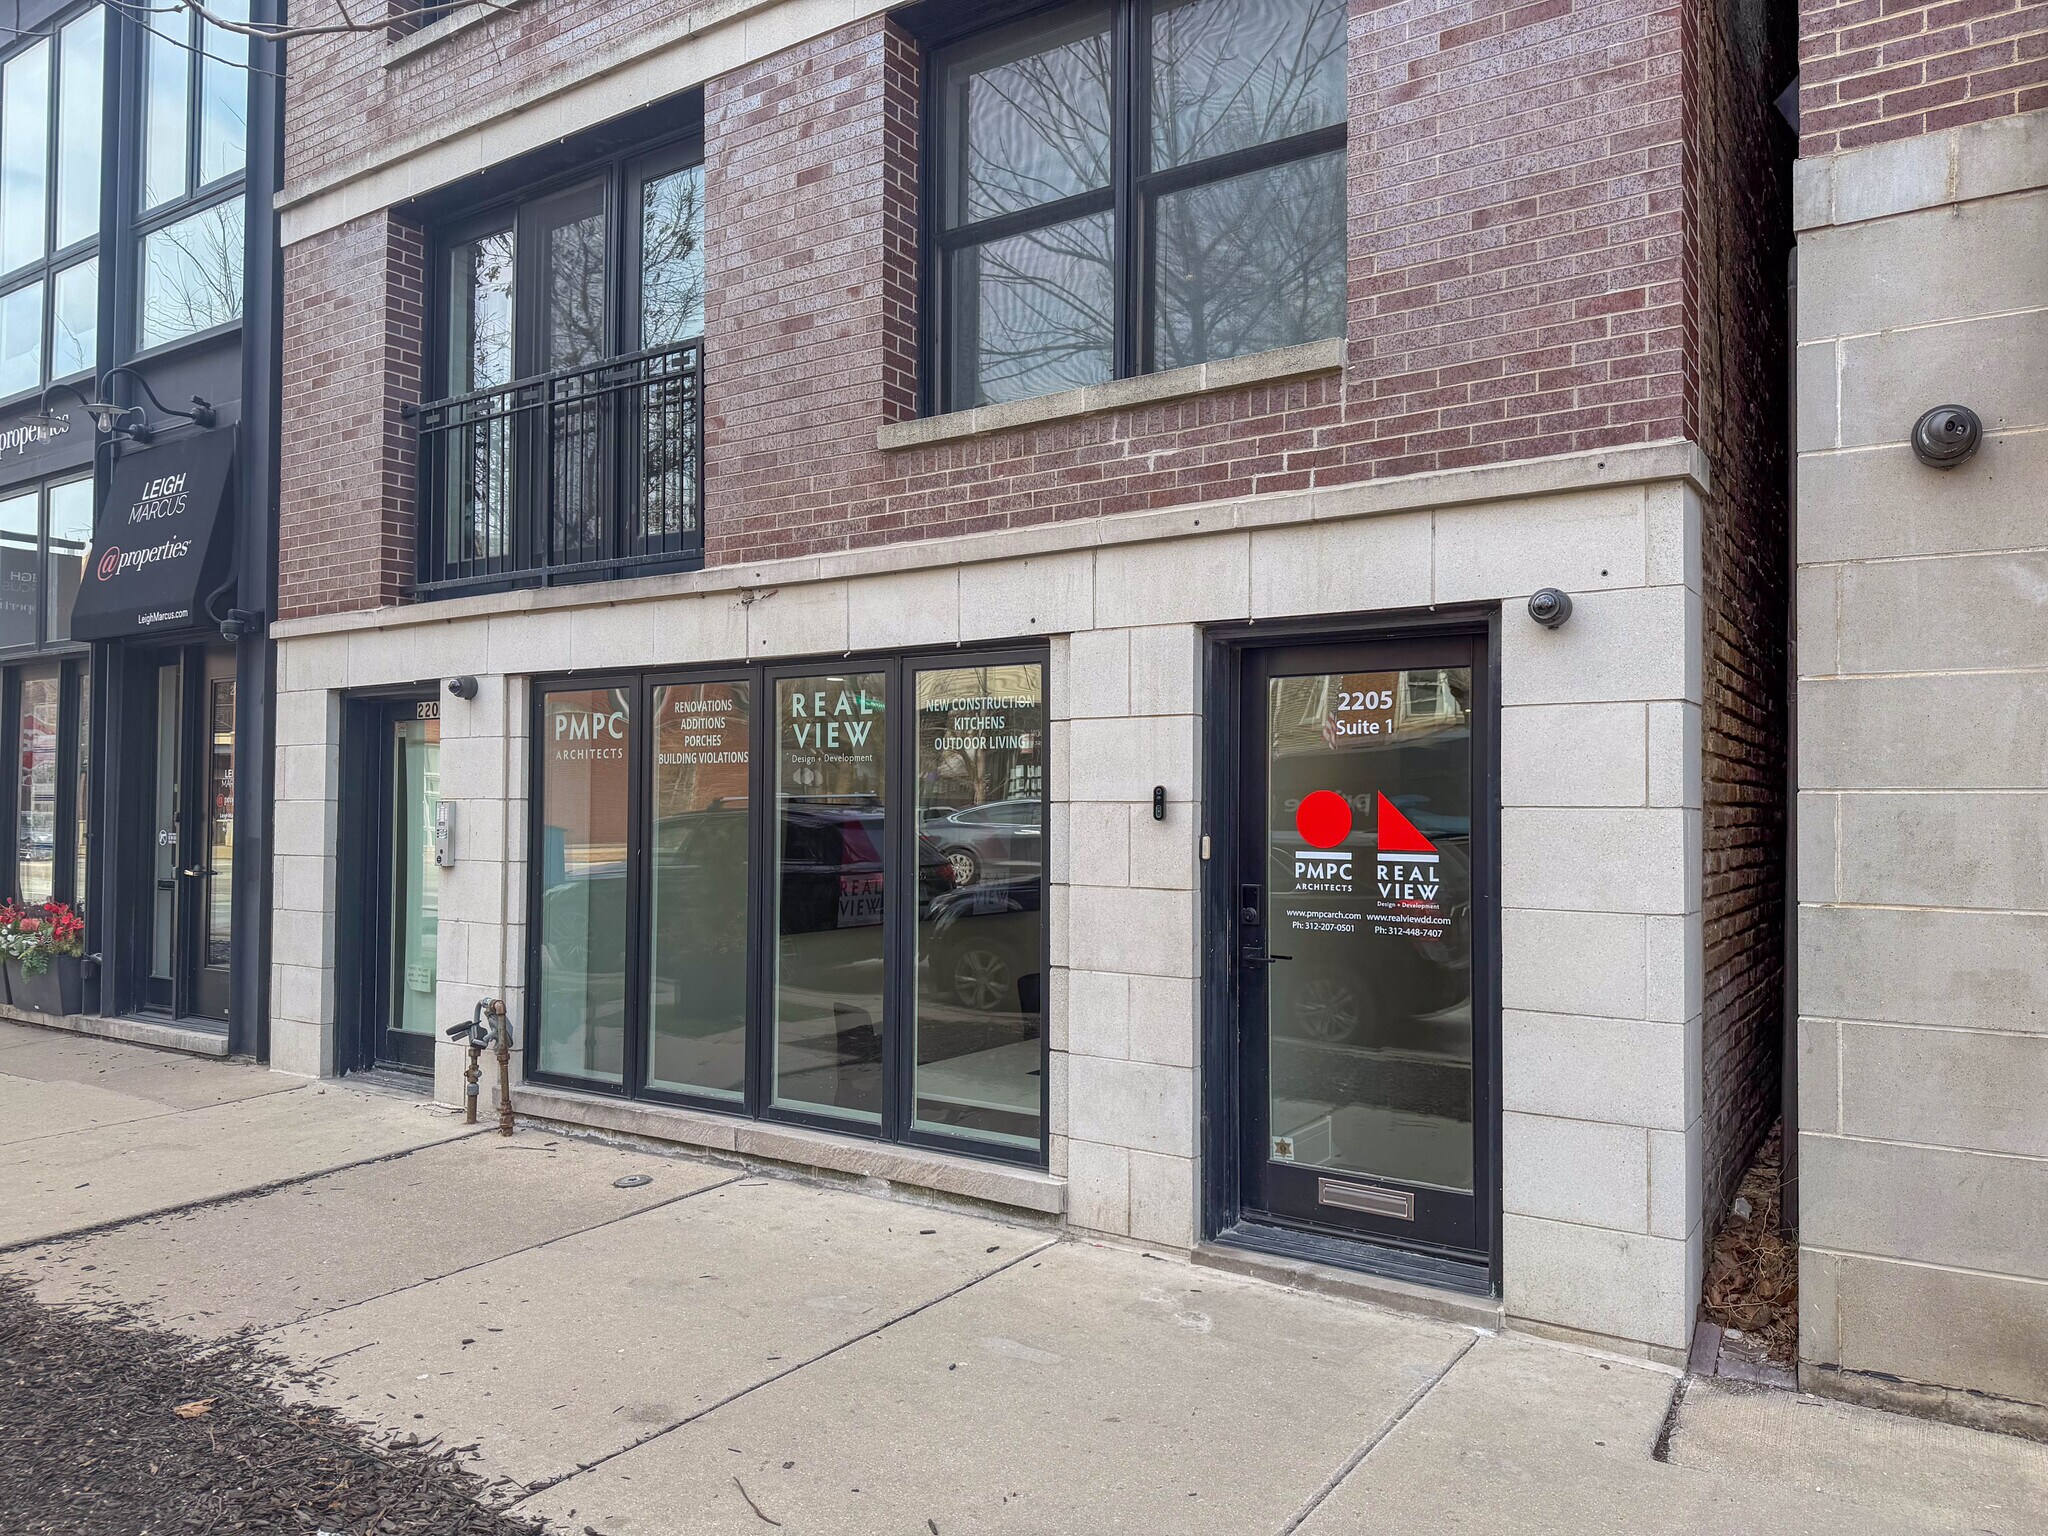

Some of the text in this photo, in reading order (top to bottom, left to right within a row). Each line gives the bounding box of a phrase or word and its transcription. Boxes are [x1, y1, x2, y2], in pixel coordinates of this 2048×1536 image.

[142, 472, 186, 501] LEIGH
[128, 494, 188, 524] MARCUS
[138, 608, 188, 625] LeighMarcus.com
[674, 699, 733, 713] RENOVATIONS
[792, 690, 873, 718] REAL
[926, 694, 1035, 712] NEW CONSTRUCTION
[1337, 690, 1393, 711] 2205
[418, 702, 440, 718] 220
[555, 711, 623, 740] PMPC
[680, 717, 726, 730] ADDITIONS
[954, 716, 1005, 730] KITCHENS
[1336, 718, 1393, 735] Suite 1
[684, 734, 721, 747] PORCHES
[793, 720, 872, 749] VIEW
[934, 733, 1026, 750] OUTDOOR LIVING
[555, 748, 623, 760] ARCHITECTS
[658, 751, 749, 765] BUILDING VIOLATIONS
[792, 754, 816, 766] Design
[824, 752, 873, 765] Development
[1295, 862, 1353, 880] PMPC
[1377, 864, 1439, 882] REAL
[1295, 883, 1352, 892] ARCHITECTS
[1377, 882, 1439, 900] VIEW
[1377, 901, 1396, 909] Design
[1401, 902, 1440, 910] Development
[1286, 908, 1362, 920] www.pmpcarch.com
[1366, 914, 1451, 925] www.realviewdd.com
[1292, 921, 1355, 933] Ph: 312-207-0501
[1374, 925, 1443, 938] Ph: 312-448-7407
